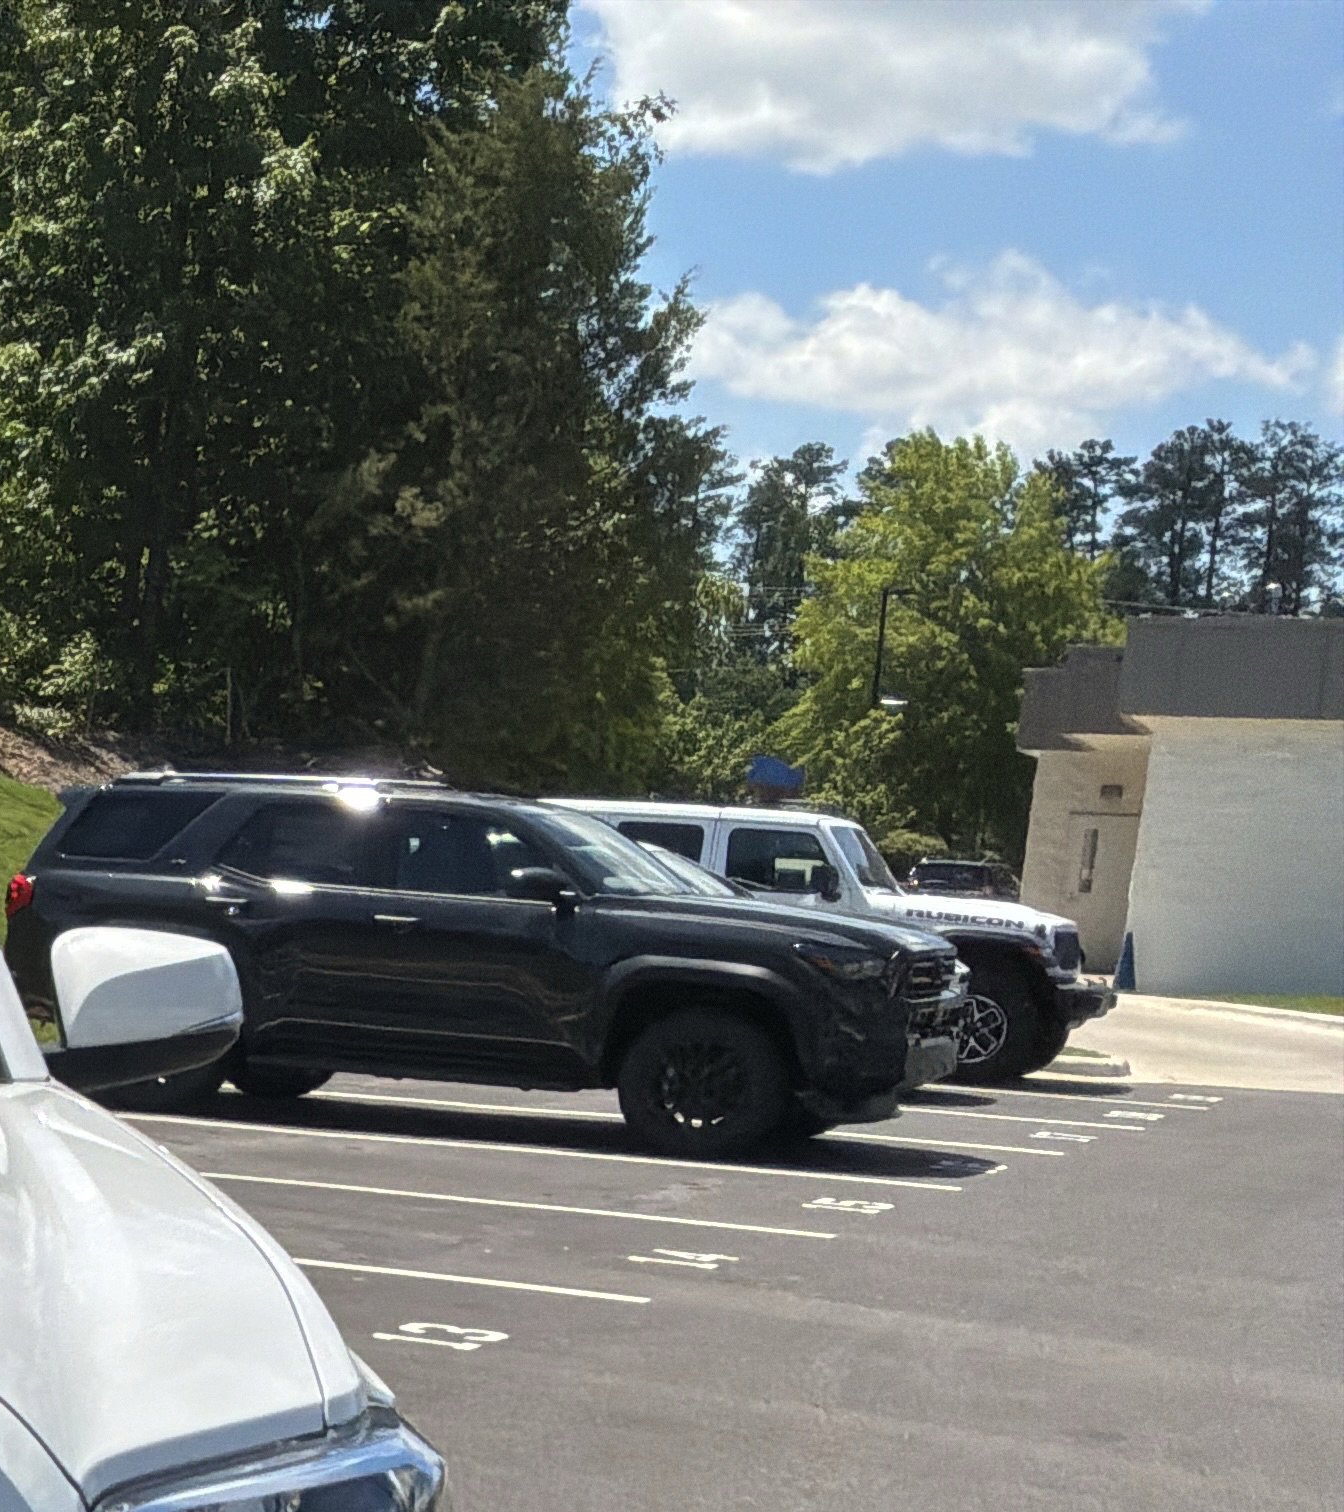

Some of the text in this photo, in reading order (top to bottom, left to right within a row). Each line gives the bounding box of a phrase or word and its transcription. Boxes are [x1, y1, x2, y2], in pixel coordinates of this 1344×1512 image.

[906, 908, 1025, 929] RUBICON
[801, 1197, 895, 1215] 15
[627, 1248, 740, 1270] 14
[372, 1322, 510, 1351] 13
